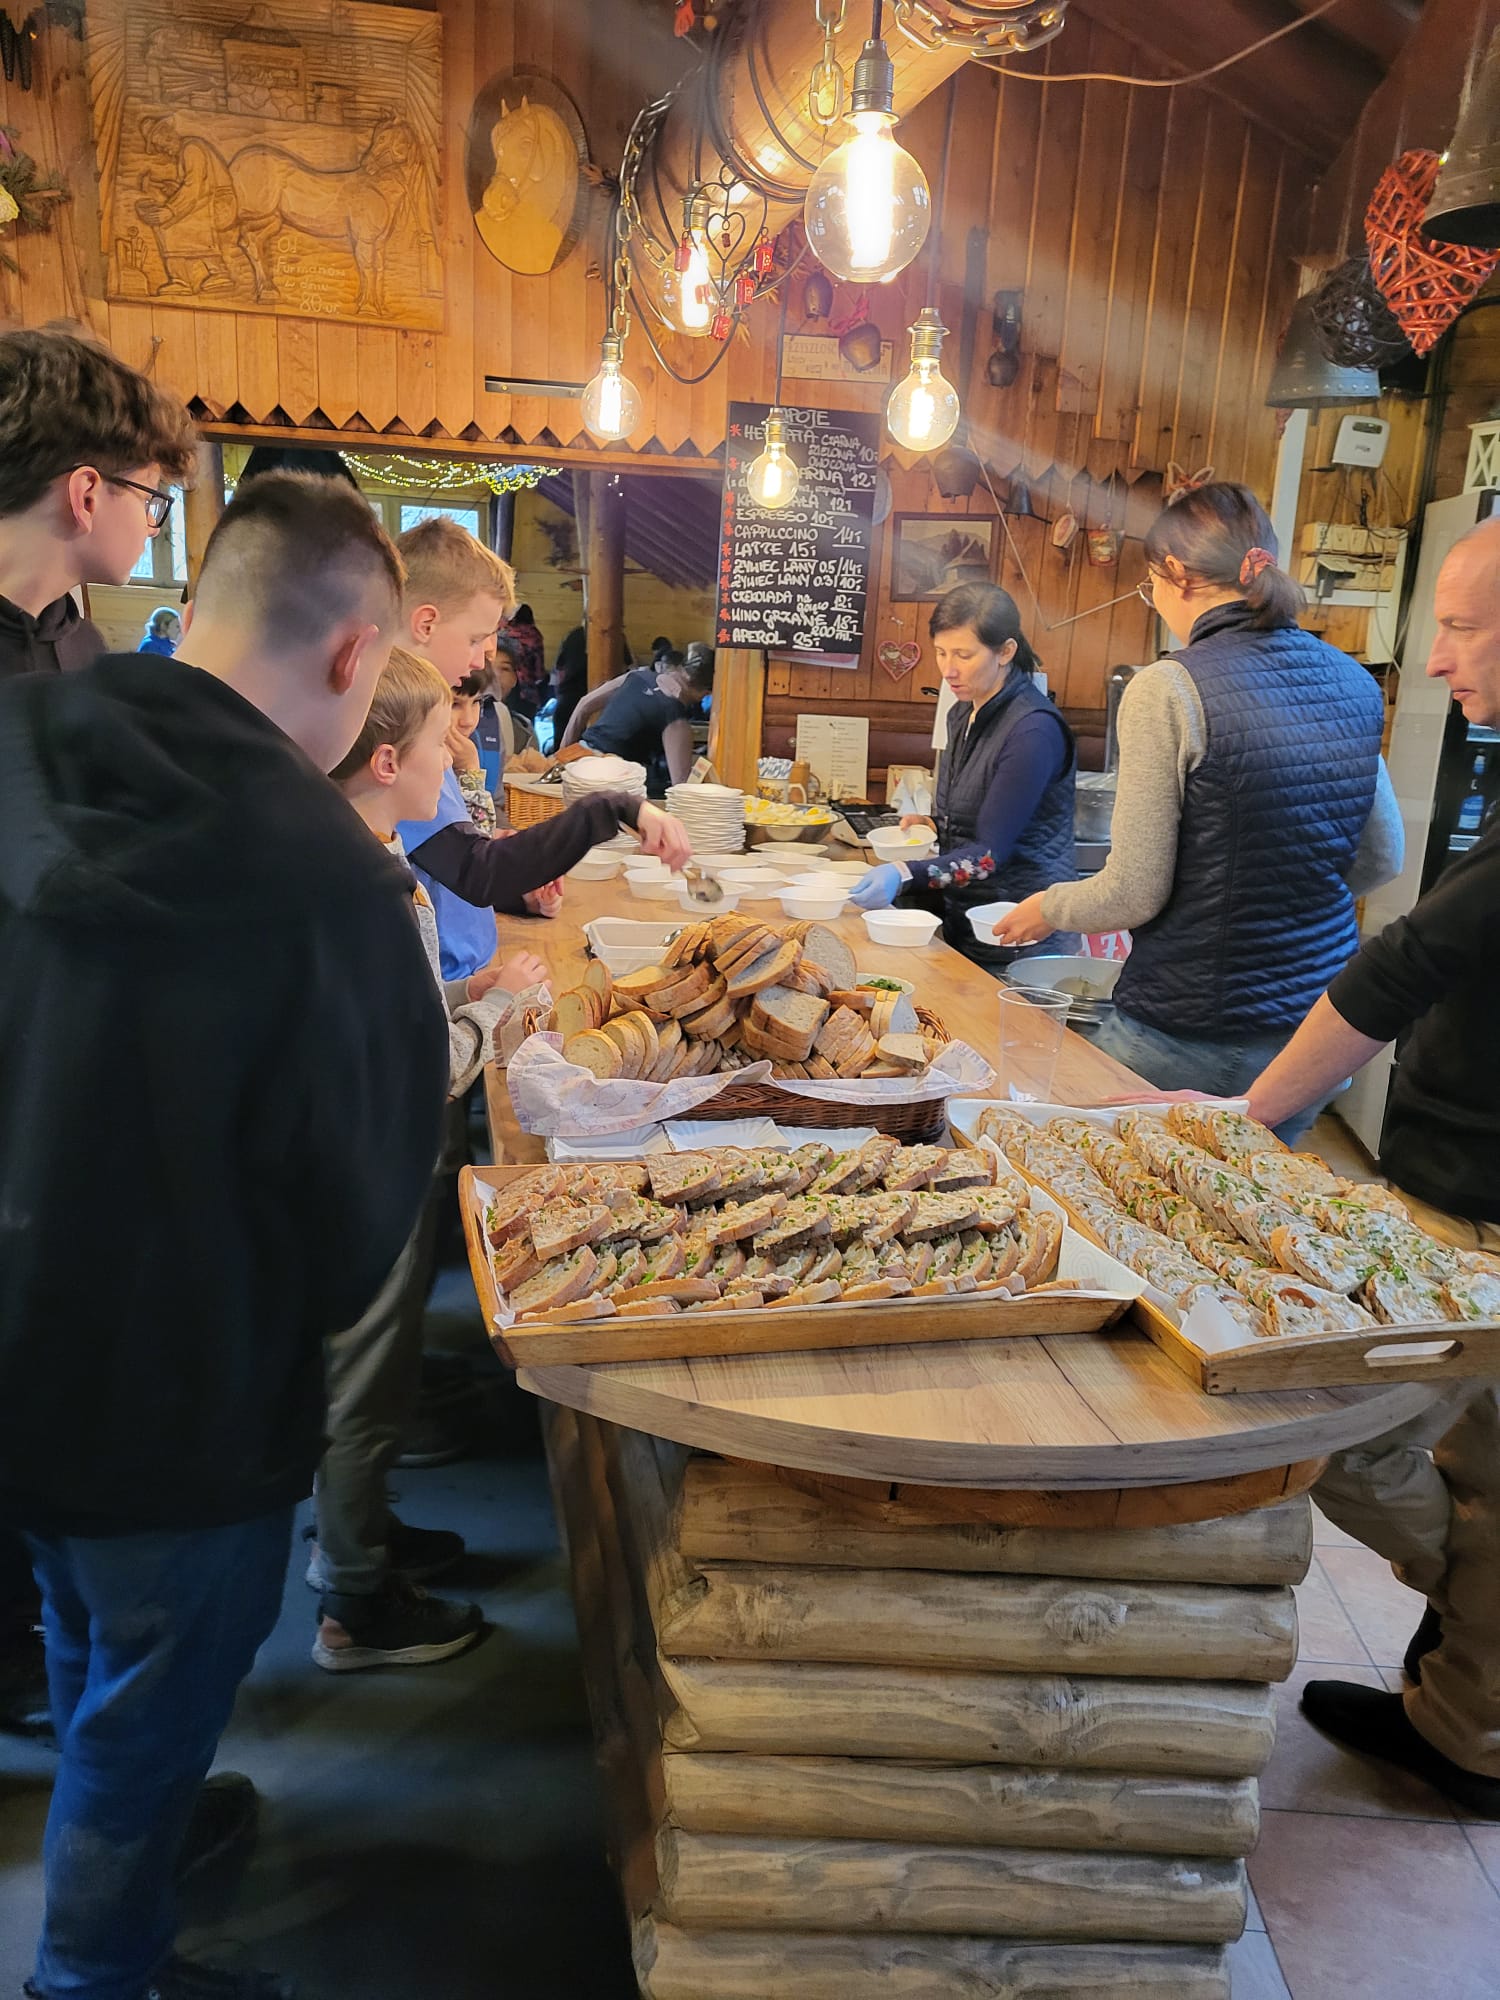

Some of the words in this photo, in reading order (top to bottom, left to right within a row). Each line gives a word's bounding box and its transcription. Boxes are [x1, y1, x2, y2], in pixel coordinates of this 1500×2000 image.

[736, 508, 808, 523] ESPRESSO
[735, 524, 818, 541] CAPPUCCINO
[735, 541, 784, 558] LATTE
[783, 560, 817, 575] LANY
[777, 573, 810, 588] LANY
[731, 608, 761, 622] WINO
[732, 627, 787, 645] APEROL
